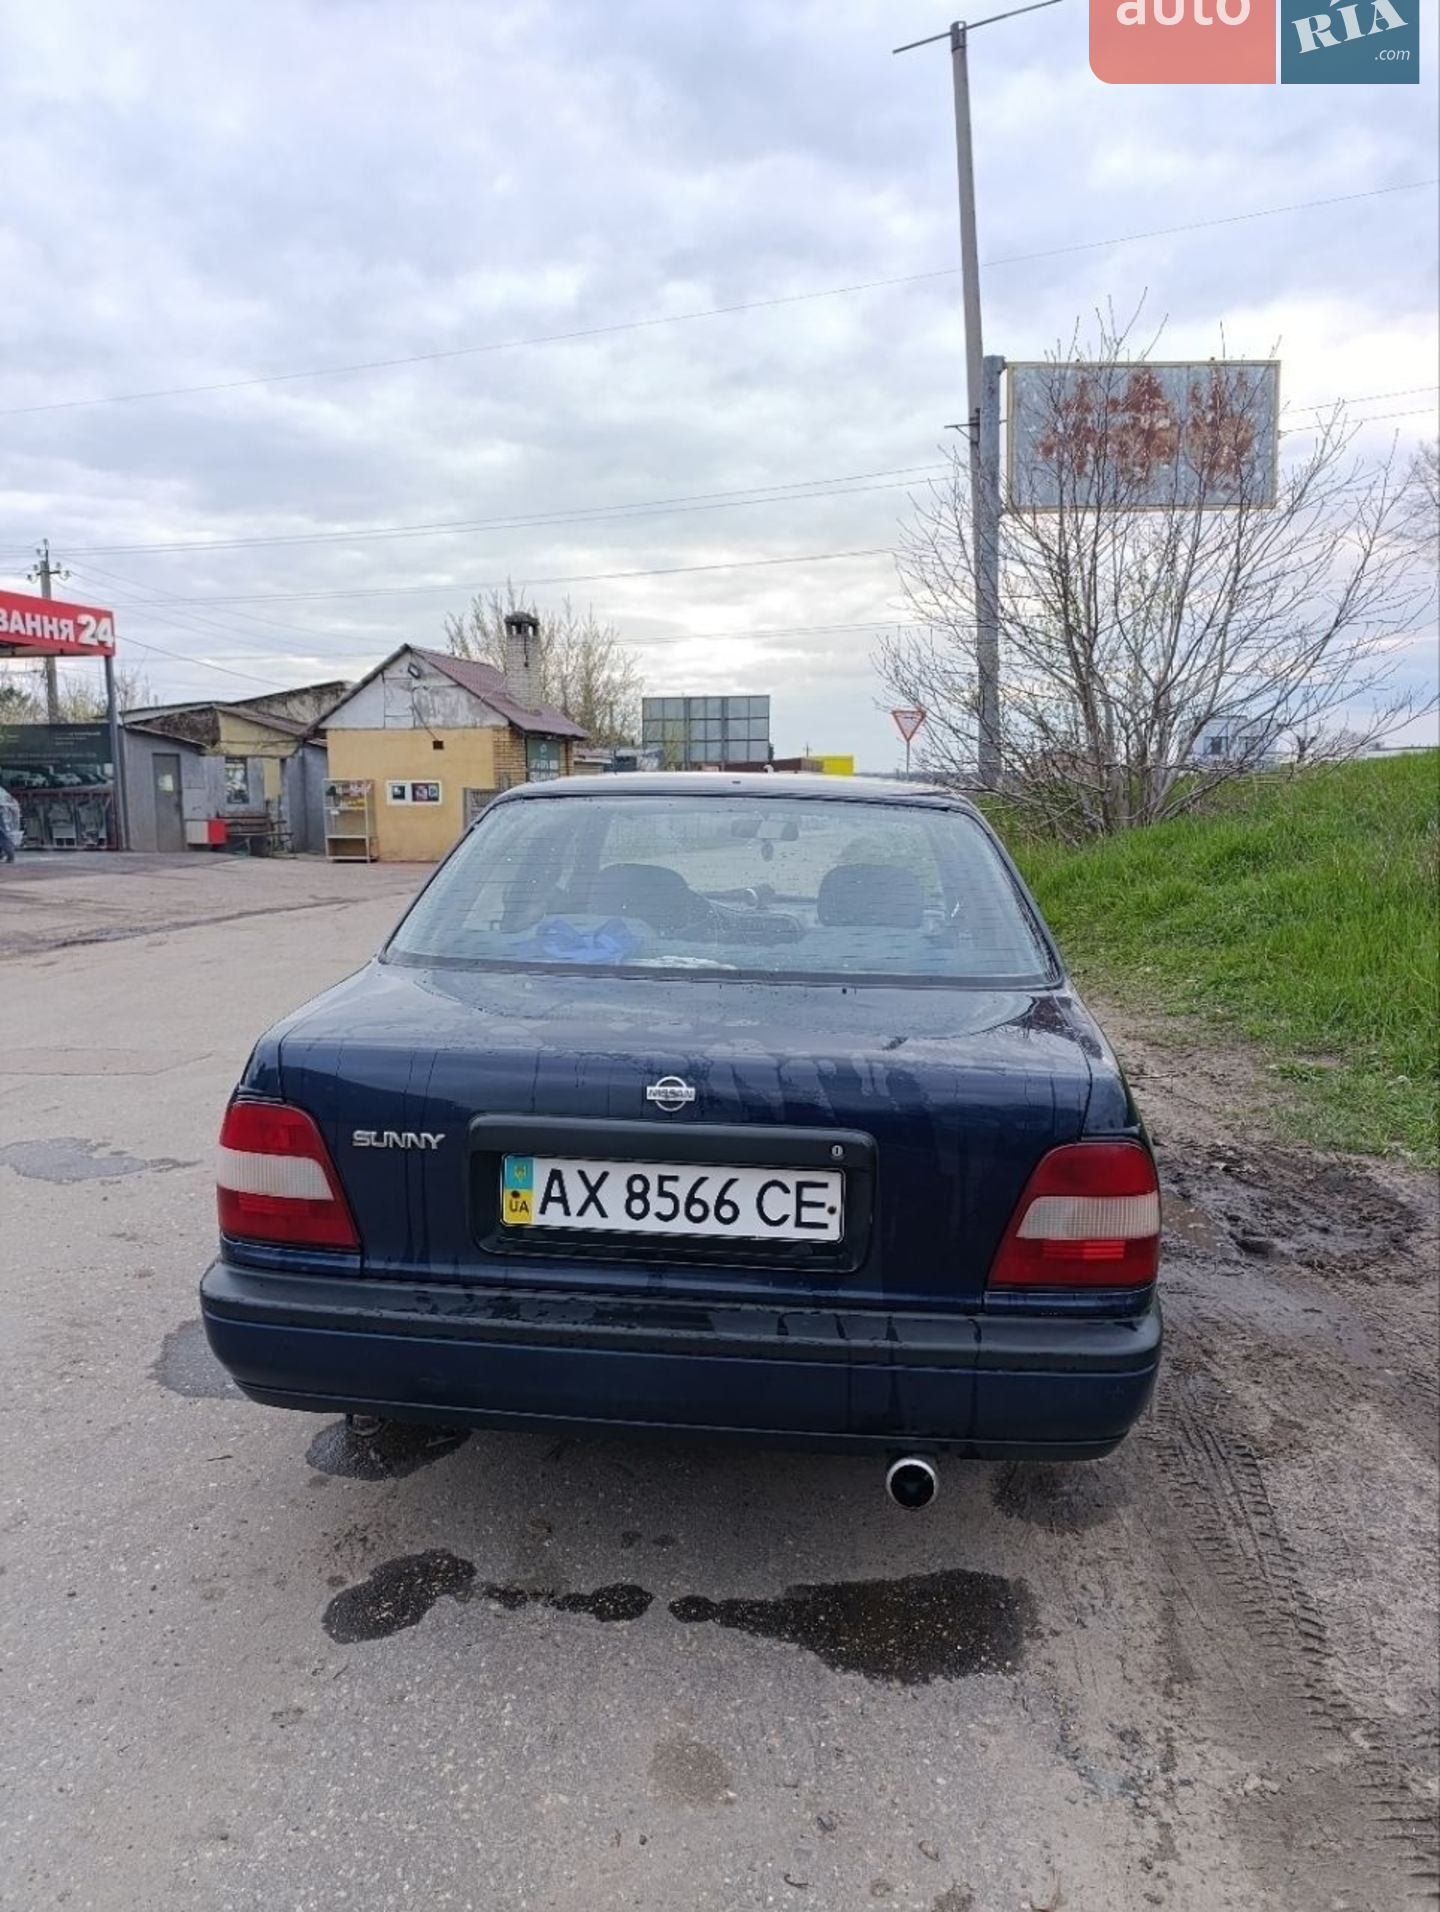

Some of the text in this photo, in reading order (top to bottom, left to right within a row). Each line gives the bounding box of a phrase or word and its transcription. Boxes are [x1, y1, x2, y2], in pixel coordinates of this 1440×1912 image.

[77, 613, 115, 648] 24
[352, 1129, 446, 1150] SUNNY
[509, 1199, 530, 1213] UA
[538, 1168, 829, 1230] AX 8566 CE
